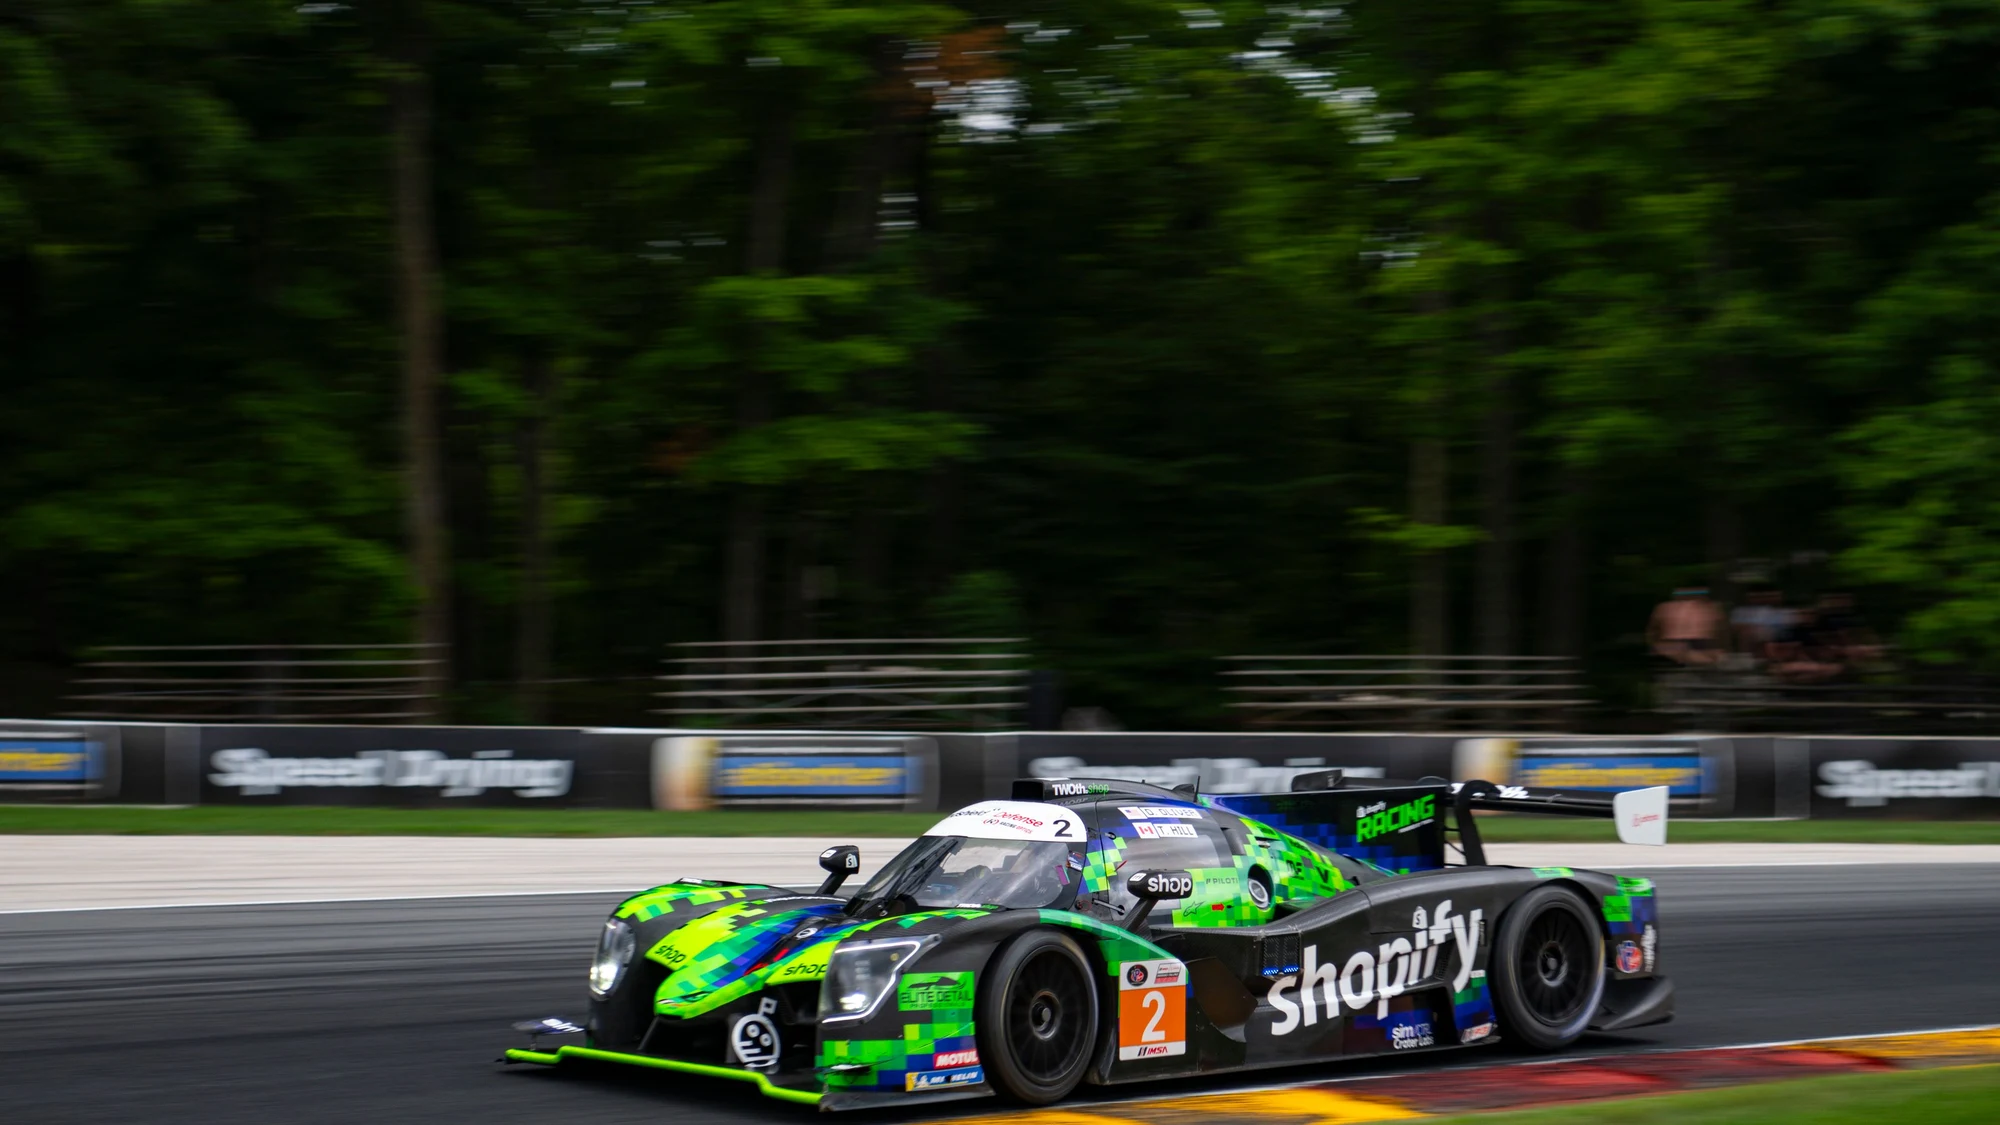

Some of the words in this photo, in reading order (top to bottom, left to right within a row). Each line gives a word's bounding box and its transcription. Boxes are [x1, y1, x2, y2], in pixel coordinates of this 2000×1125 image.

[993, 811, 1044, 828] Defense
[1158, 808, 1197, 817] OLIVER
[1356, 793, 1436, 843] RACING
[1053, 819, 1073, 837] 2
[1170, 826, 1194, 835] HILL
[1147, 874, 1192, 896] shop
[655, 944, 687, 965] shop
[784, 963, 828, 977] shop
[1267, 899, 1483, 1036] shopify
[901, 991, 934, 1004] ELITE
[1141, 990, 1166, 1043] 2
[935, 1050, 979, 1067] MOTUL
[1146, 1046, 1168, 1055] IMSA
[930, 1071, 978, 1084] MIHELIN
